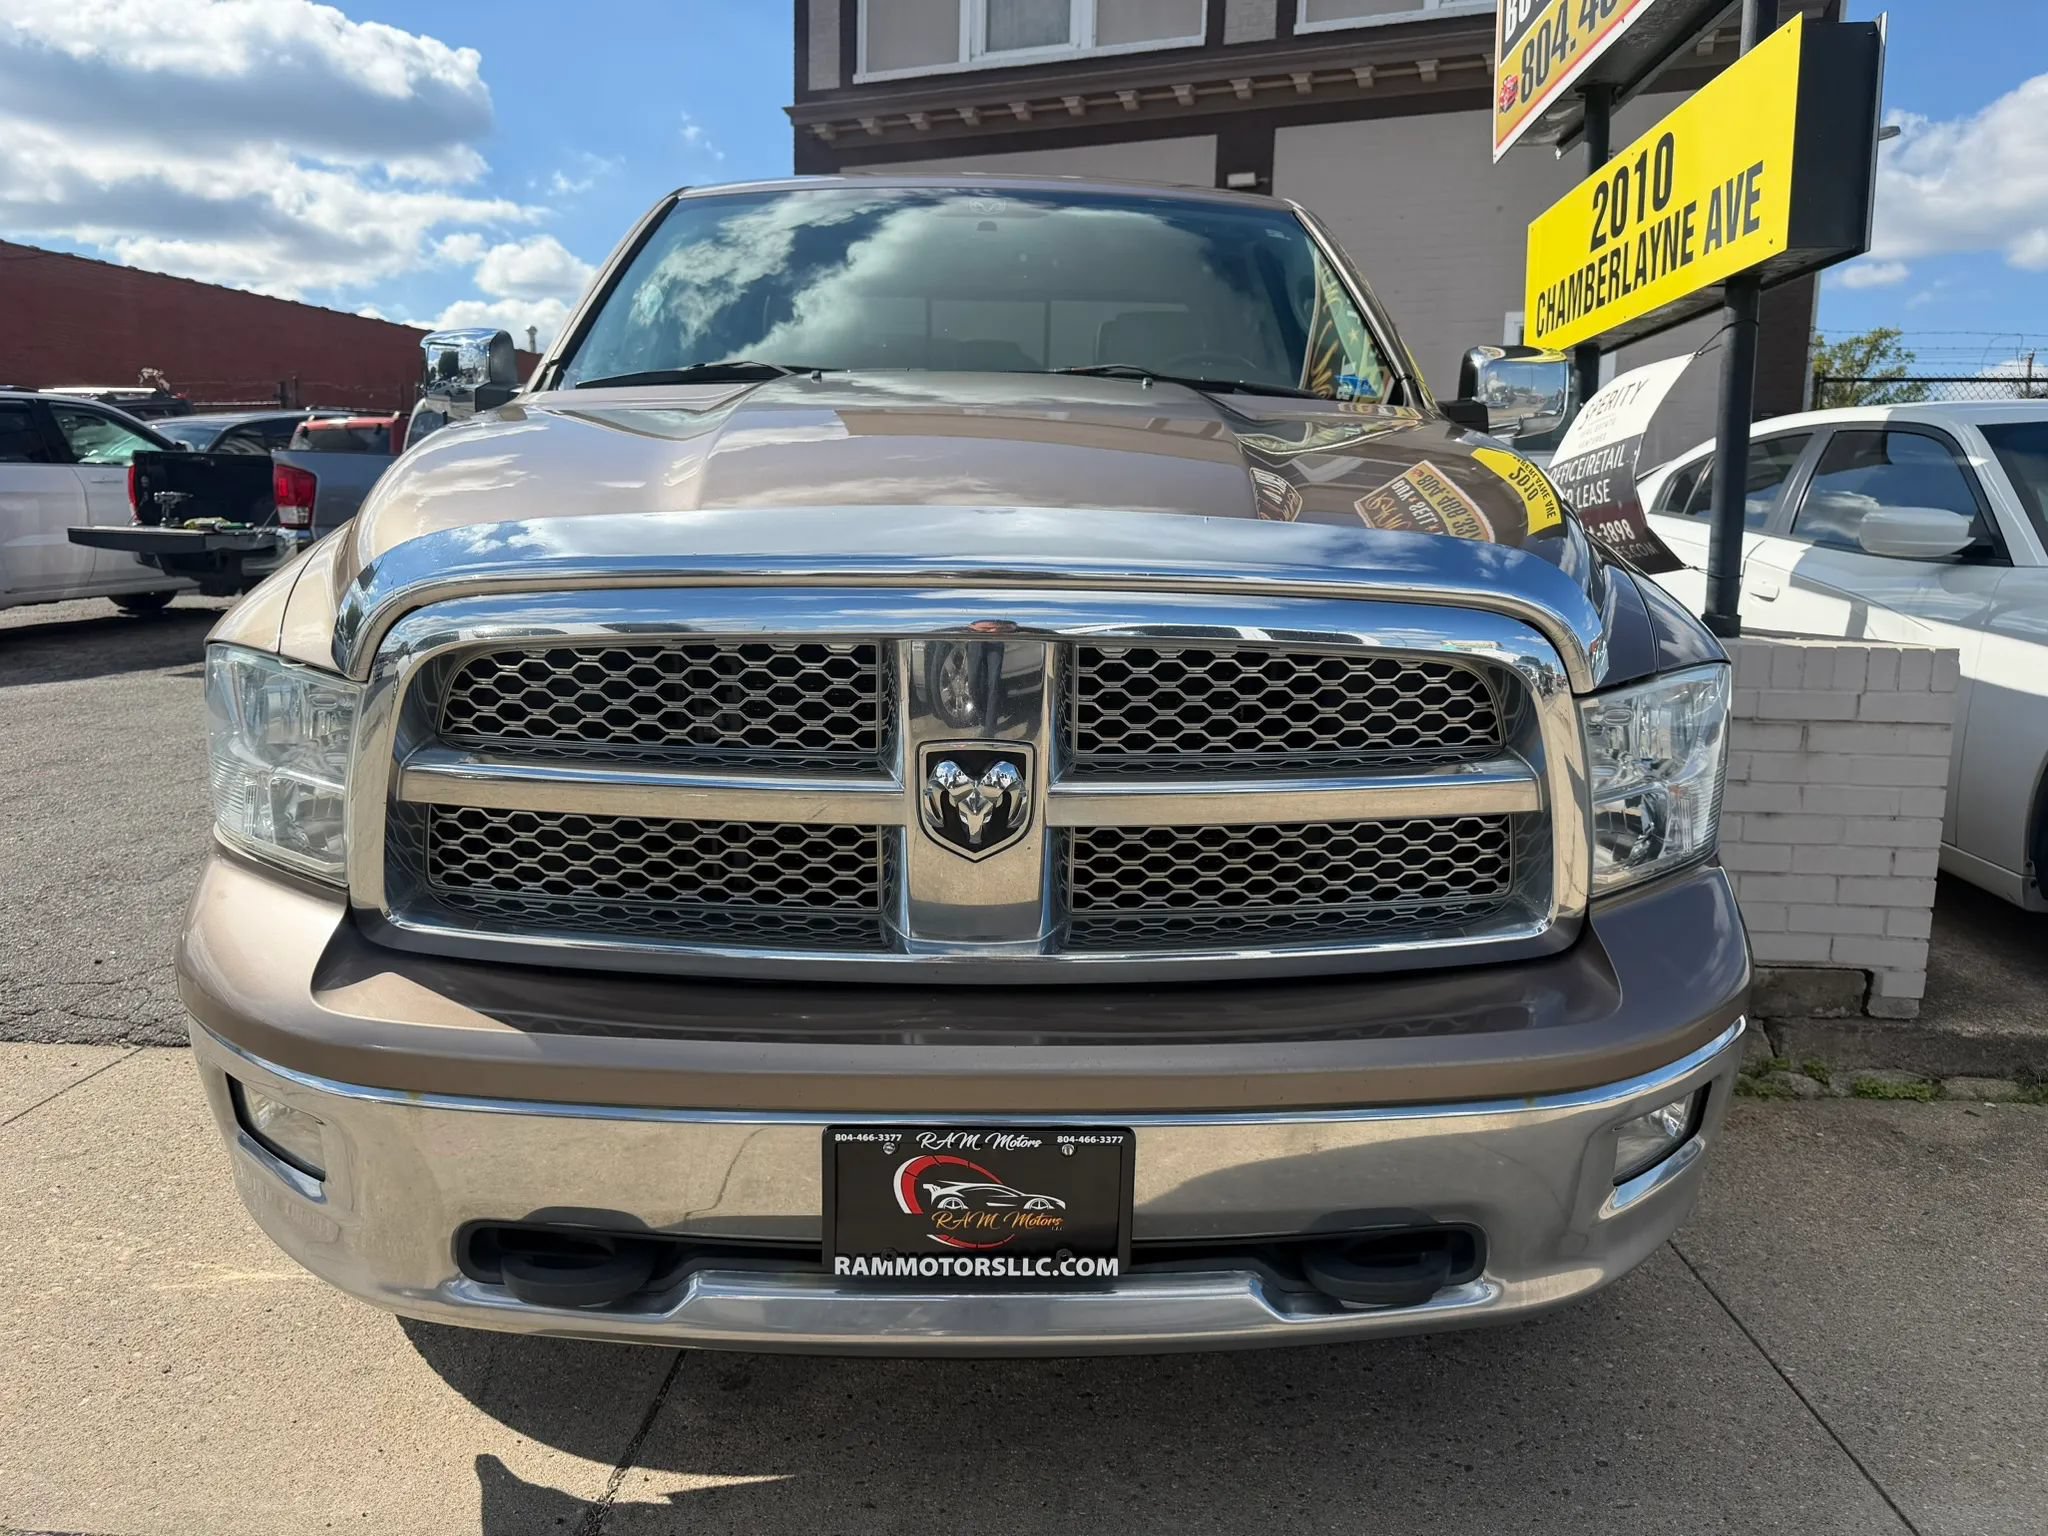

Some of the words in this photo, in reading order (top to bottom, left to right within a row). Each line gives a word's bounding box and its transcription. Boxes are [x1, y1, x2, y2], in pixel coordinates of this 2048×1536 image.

[1590, 131, 1675, 253] 2010
[1536, 199, 1697, 338] CHAMBERLAYNE
[1703, 159, 1764, 256] AVE
[1576, 478, 1612, 508] LEASE
[834, 1133, 903, 1142] 804-466-3377
[915, 1131, 981, 1151] RAM
[984, 1132, 1043, 1151] Motors
[1056, 1135, 1124, 1144] 804-466-3377
[931, 1210, 1001, 1230] RAM
[1003, 1211, 1063, 1230] Motors
[834, 1256, 1120, 1278] RAMMOTORSLLC.COM
